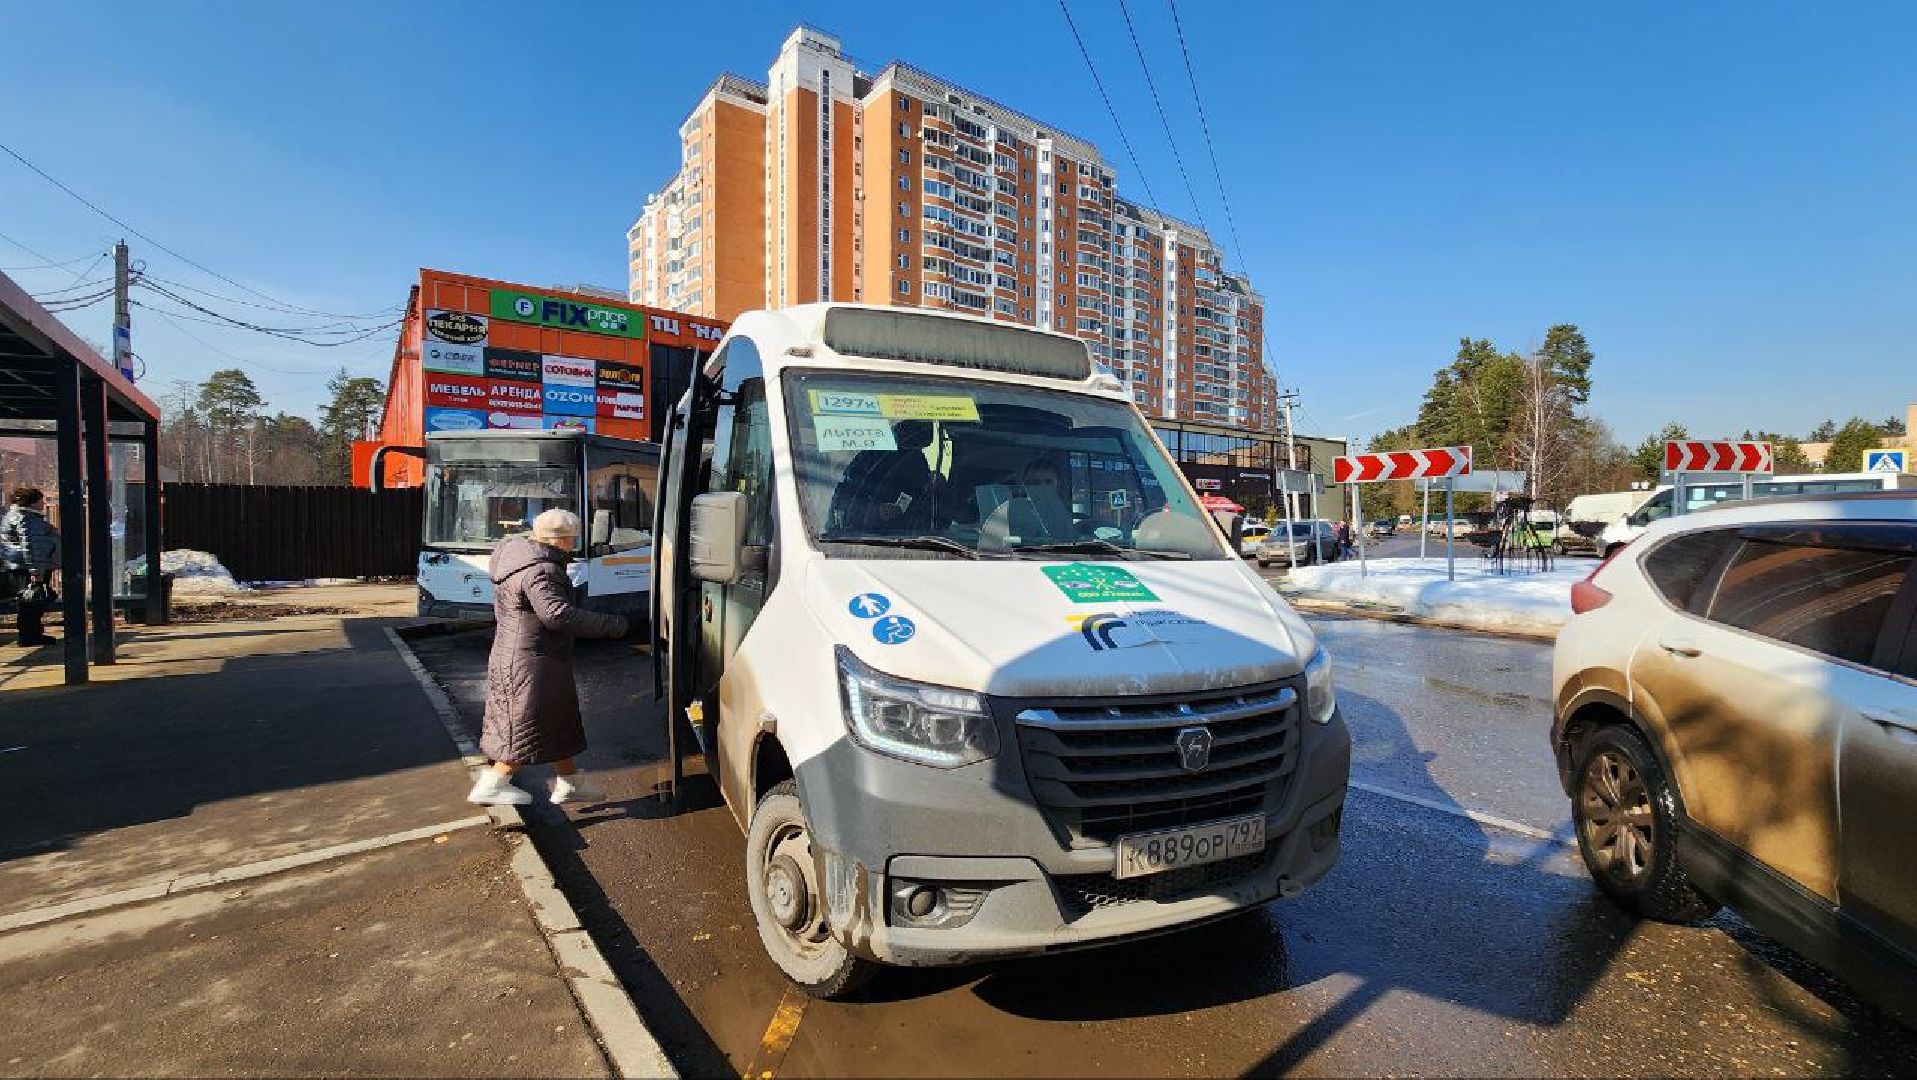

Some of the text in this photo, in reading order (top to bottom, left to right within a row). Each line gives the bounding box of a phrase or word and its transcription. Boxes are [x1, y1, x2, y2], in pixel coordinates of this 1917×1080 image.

[542, 300, 627, 328] FIX price
[429, 319, 487, 335] ПЕКАРНЯ
[651, 315, 680, 336] ТЦ
[430, 383, 486, 397] МЕБЕЛЬ
[490, 385, 541, 400] АРЕНДА
[545, 390, 594, 404] OZON
[1228, 819, 1261, 845] 797
